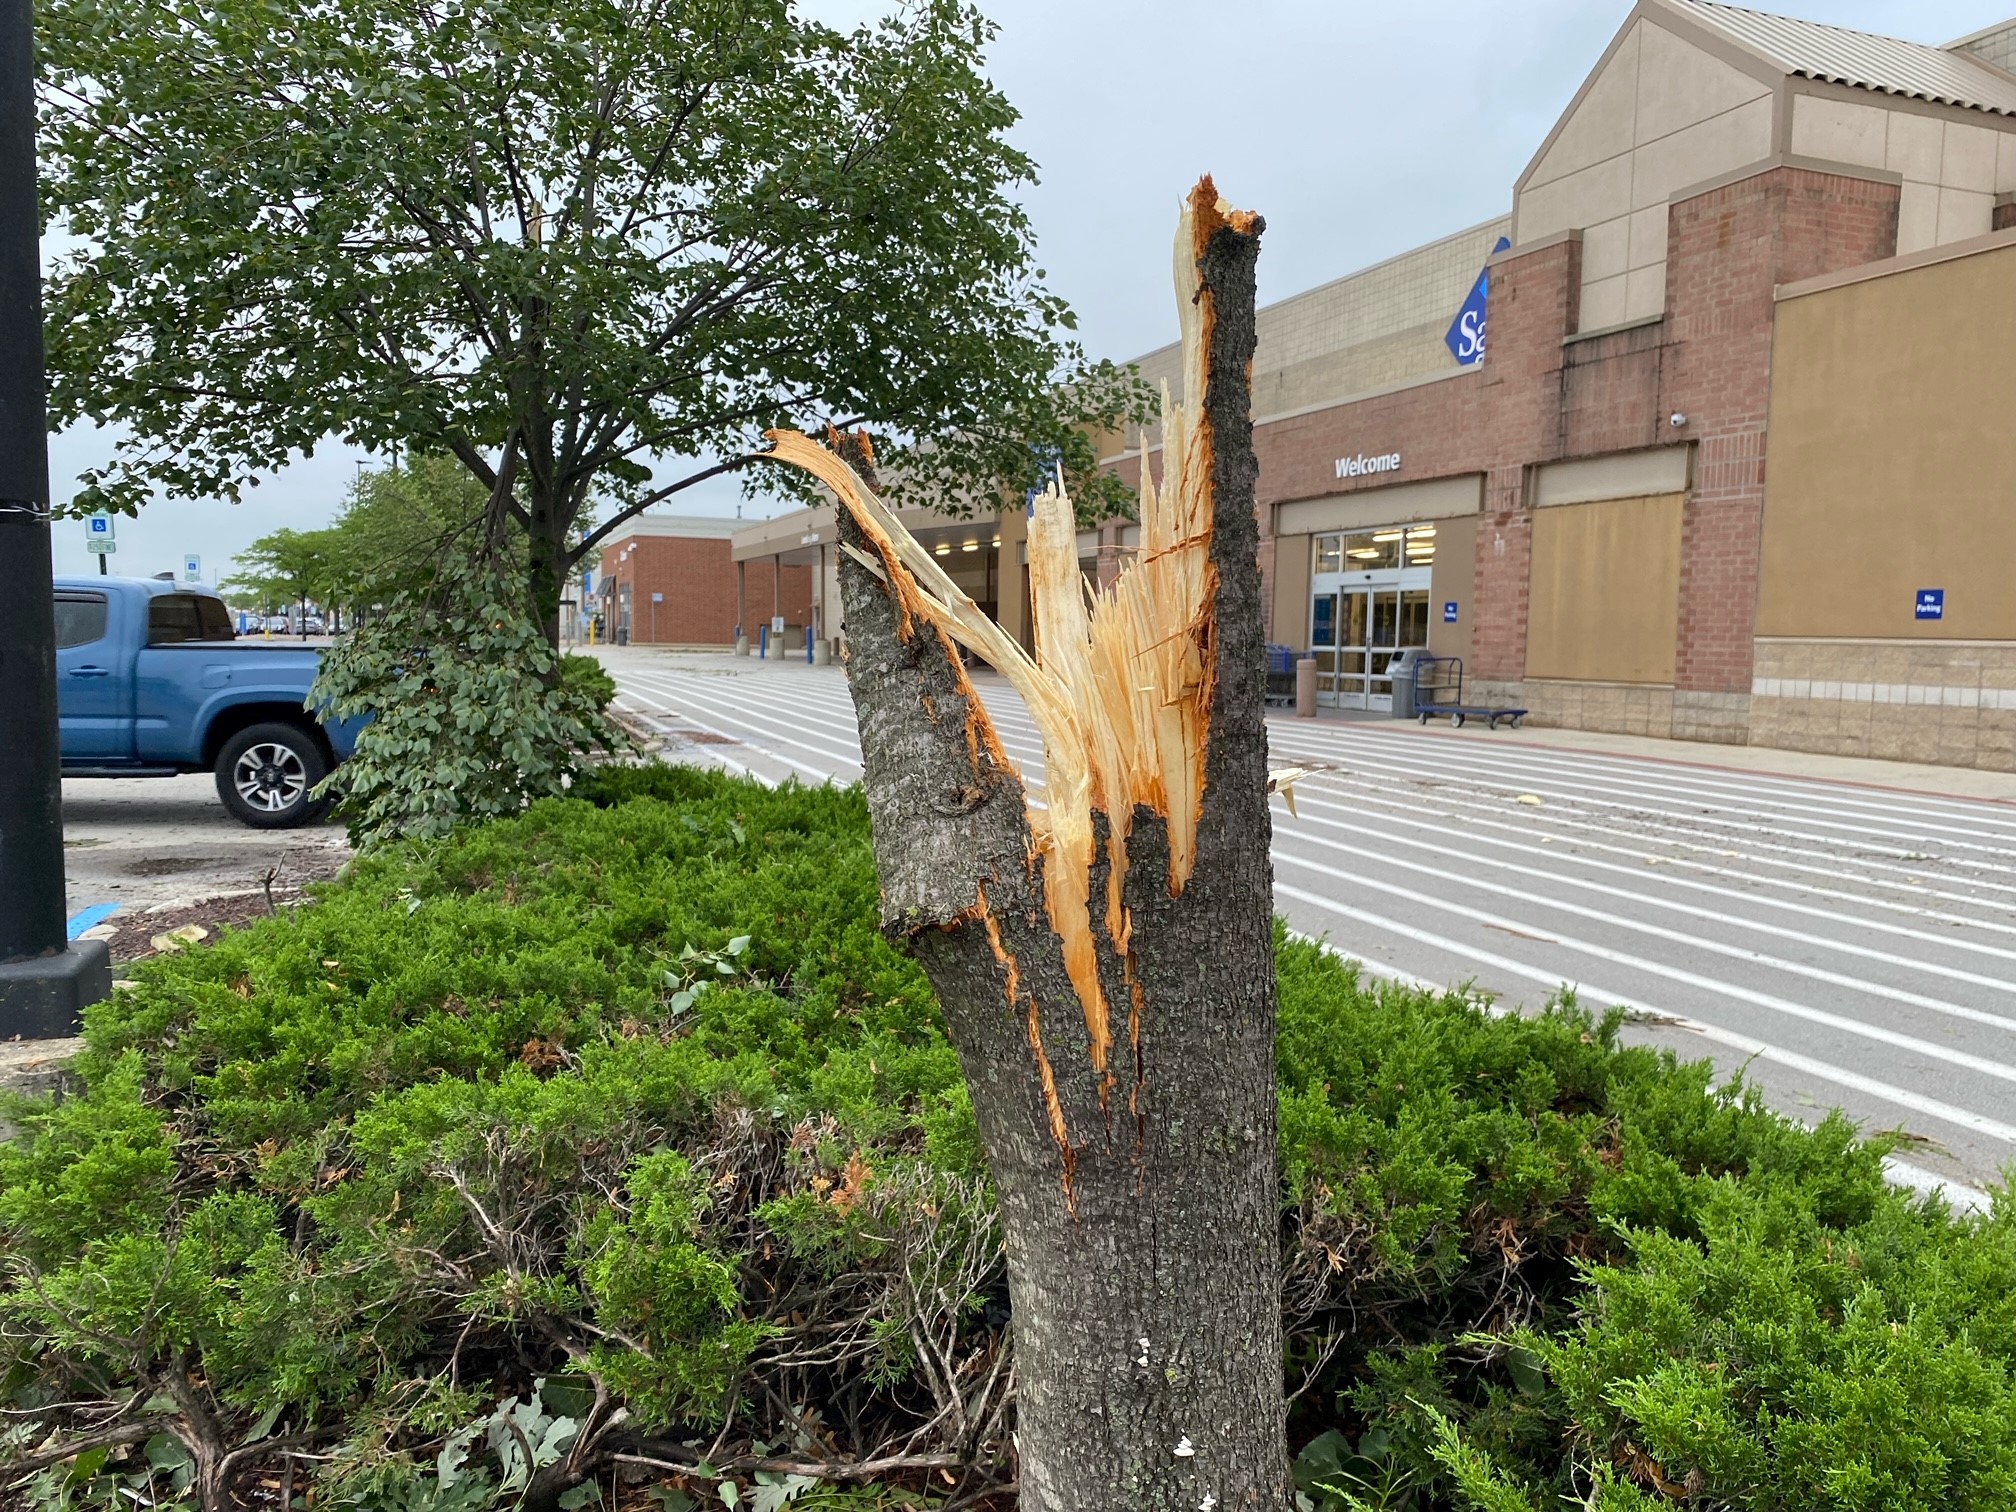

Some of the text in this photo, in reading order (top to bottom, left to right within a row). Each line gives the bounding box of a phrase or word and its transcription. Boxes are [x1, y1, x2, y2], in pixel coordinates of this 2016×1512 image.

[1335, 453, 1400, 478] Welcome
[1924, 594, 1935, 603] No
[1916, 604, 1941, 614] Parking
